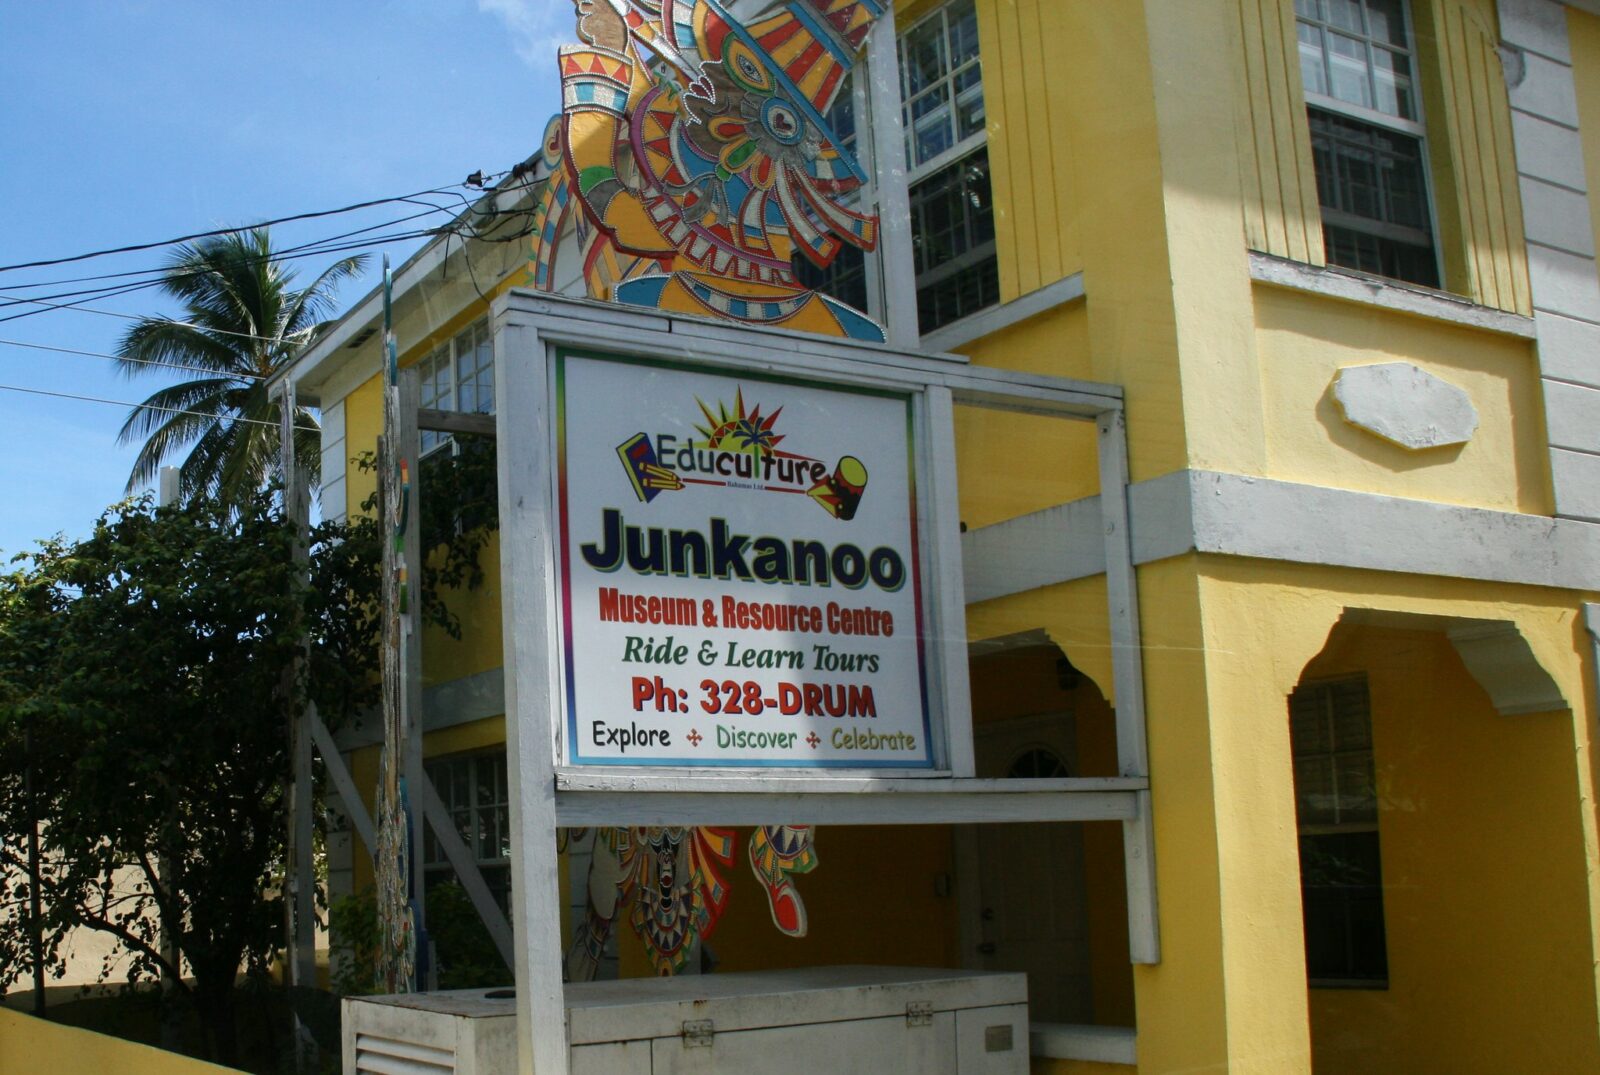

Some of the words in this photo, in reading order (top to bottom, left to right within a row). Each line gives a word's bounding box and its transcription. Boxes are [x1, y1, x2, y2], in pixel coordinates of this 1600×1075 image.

[656, 434, 826, 486] Educulture
[580, 508, 906, 591] Junkanoo
[599, 587, 697, 626] Museum
[702, 600, 718, 627] &
[722, 596, 822, 634] Resource
[827, 602, 893, 636] Centre
[622, 636, 688, 665] Ride
[697, 640, 718, 665] &
[725, 641, 804, 669] Learn
[813, 645, 880, 673] Tours
[631, 676, 689, 714] Ph:
[699, 679, 877, 718] 328-DRUM
[592, 721, 671, 752] Explore
[716, 725, 797, 749] Discover
[831, 727, 916, 751] Celebrate
